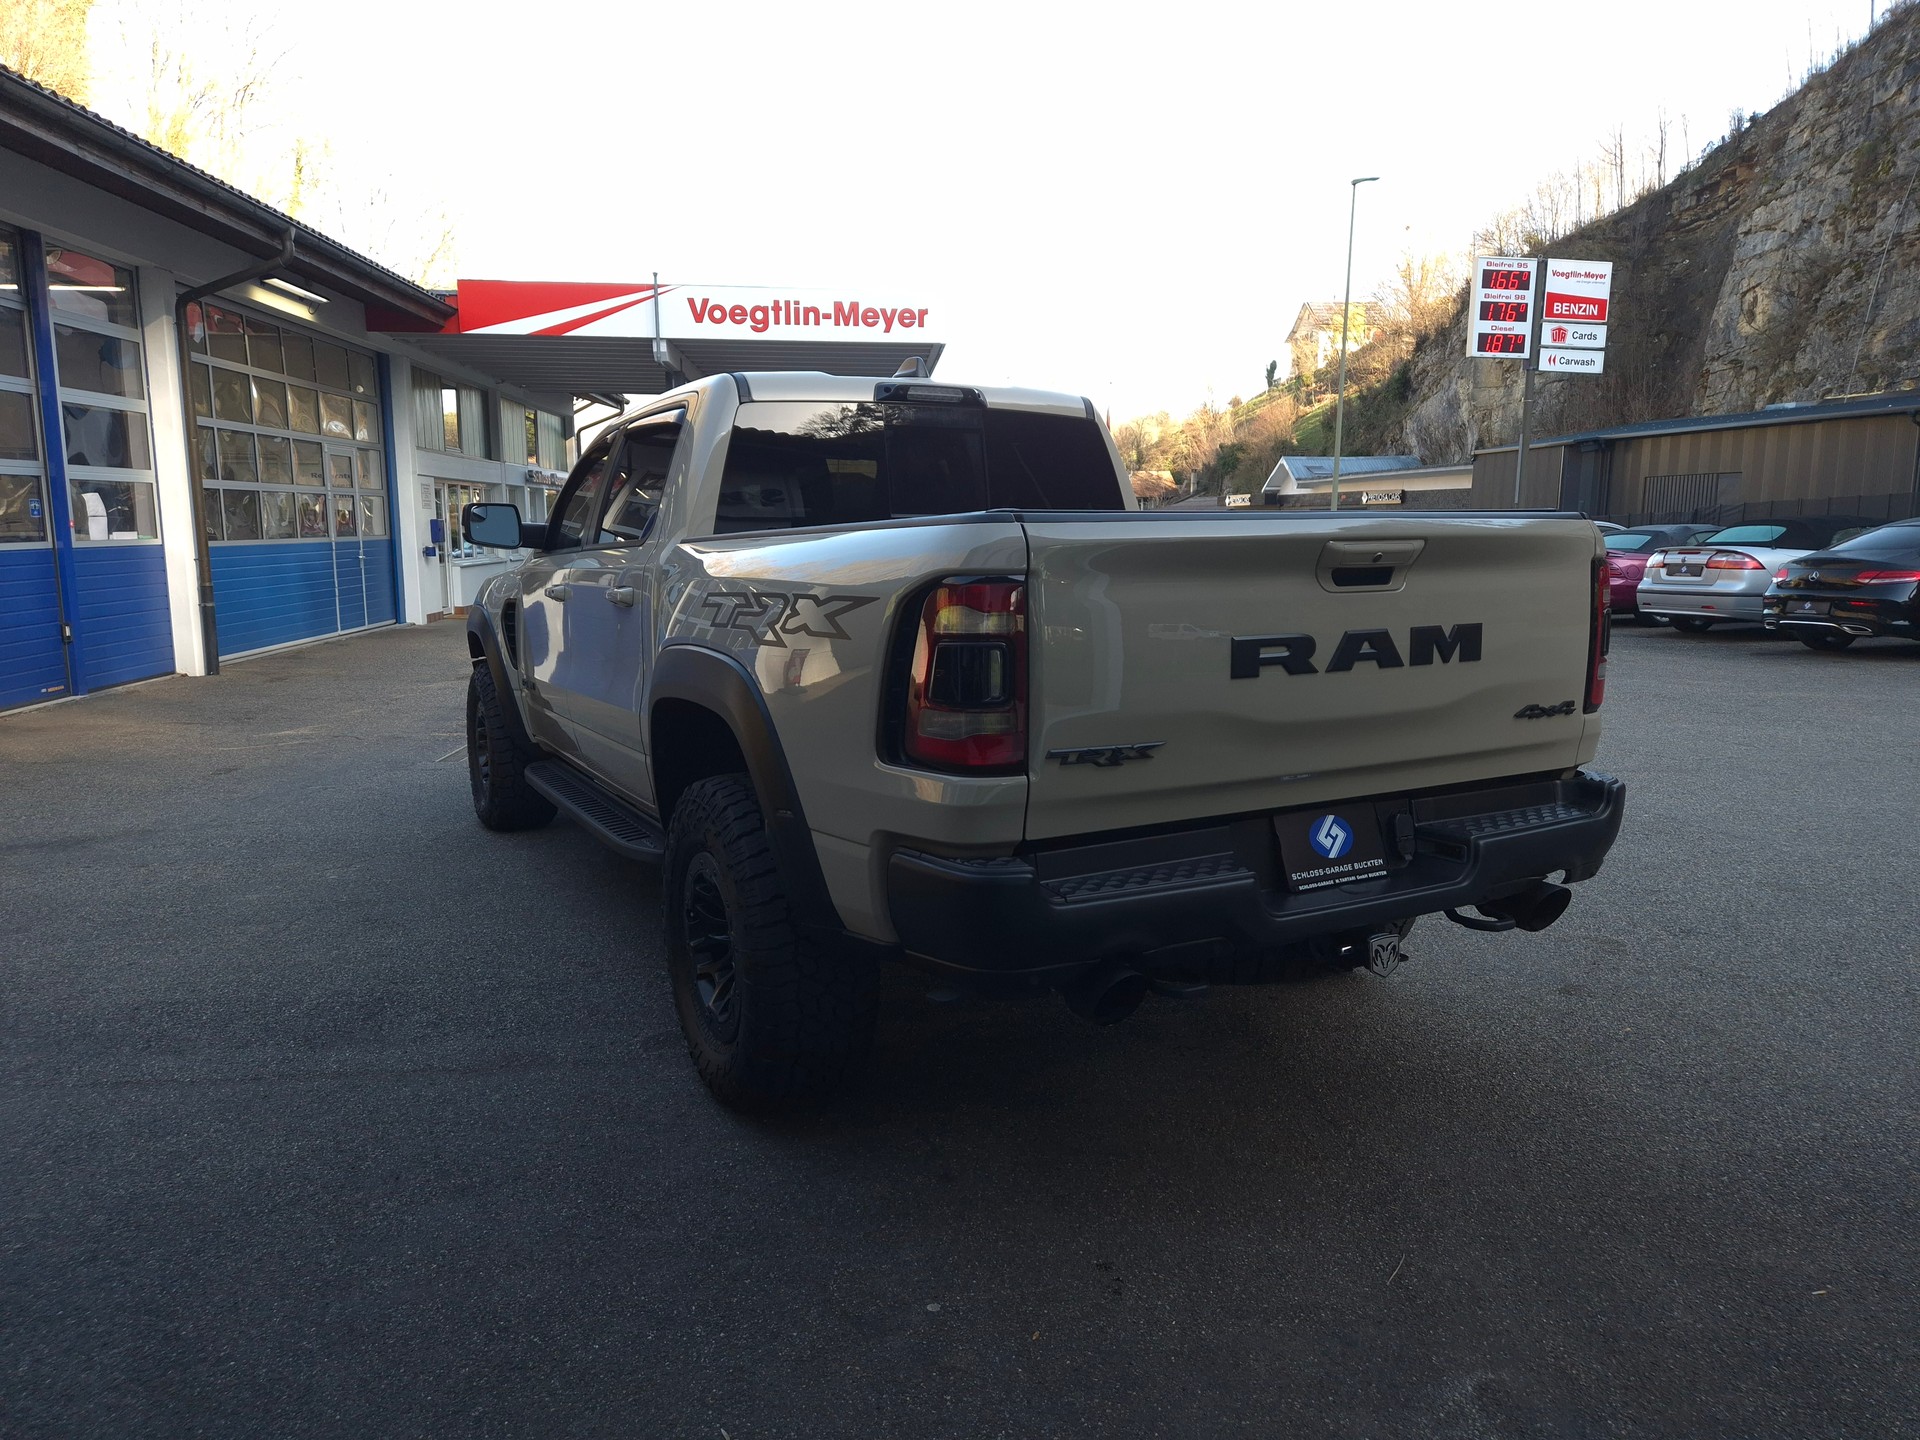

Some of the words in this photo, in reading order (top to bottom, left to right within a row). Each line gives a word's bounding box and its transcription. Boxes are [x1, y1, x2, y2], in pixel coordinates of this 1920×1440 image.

[1486, 260, 1514, 268] Bleifrei
[1551, 269, 1607, 281] Voegtlin-Meyer
[1483, 292, 1512, 300] Bleifrei
[686, 297, 928, 333] Voegtlin-Meyer
[1553, 302, 1599, 316] BENZIN
[1571, 331, 1598, 341] Cards
[1558, 356, 1596, 367] Carwash
[701, 592, 881, 648] TRX
[1230, 622, 1483, 680] RAM
[1513, 700, 1577, 720] 4x4
[1045, 741, 1167, 768] TRX
[1291, 863, 1353, 881] SCHLOSS-GARAGE
[1354, 858, 1384, 869] BUCKTEN
[1298, 879, 1335, 891] SCHLOSS-GARAGE
[1368, 870, 1388, 878] BUCKTEN
